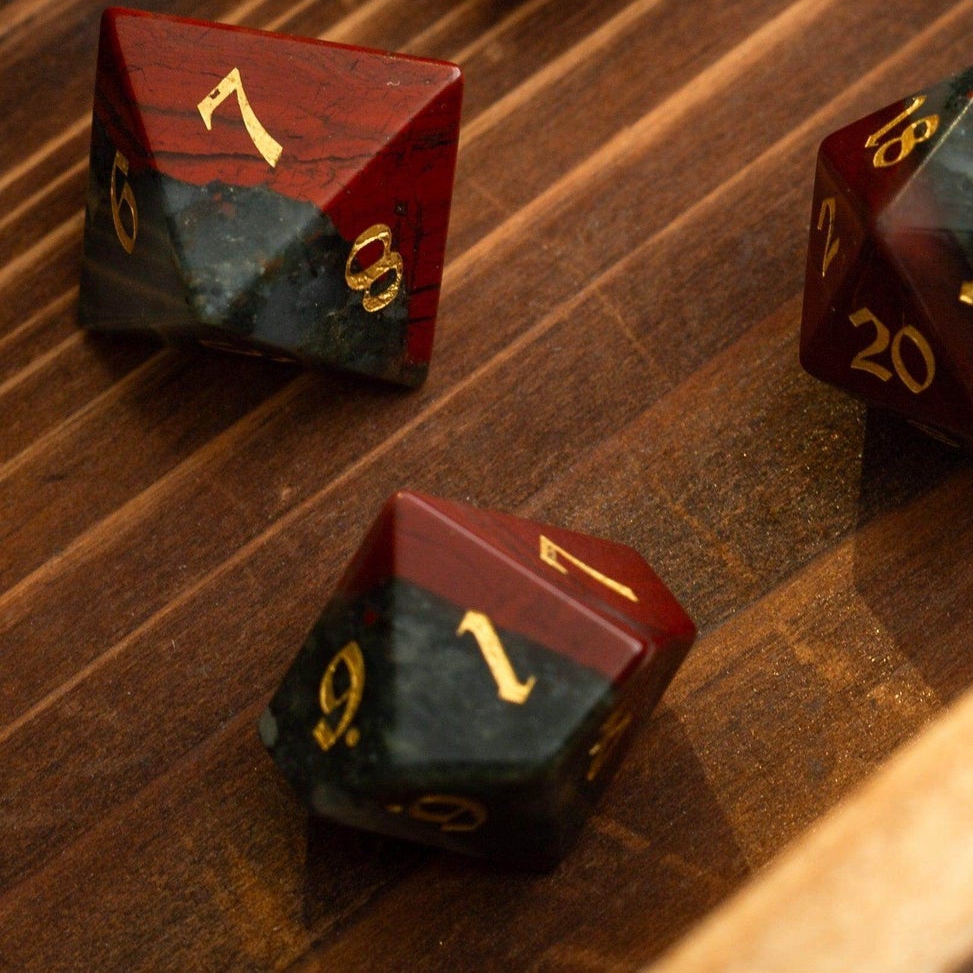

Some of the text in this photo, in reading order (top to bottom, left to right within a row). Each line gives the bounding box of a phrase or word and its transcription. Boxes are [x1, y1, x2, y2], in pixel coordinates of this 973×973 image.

[197, 67, 284, 168] 7
[864, 95, 940, 169] 18
[345, 223, 404, 313] 8
[848, 307, 937, 395] 20
[539, 534, 639, 602] 7
[456, 610, 537, 705] 1
